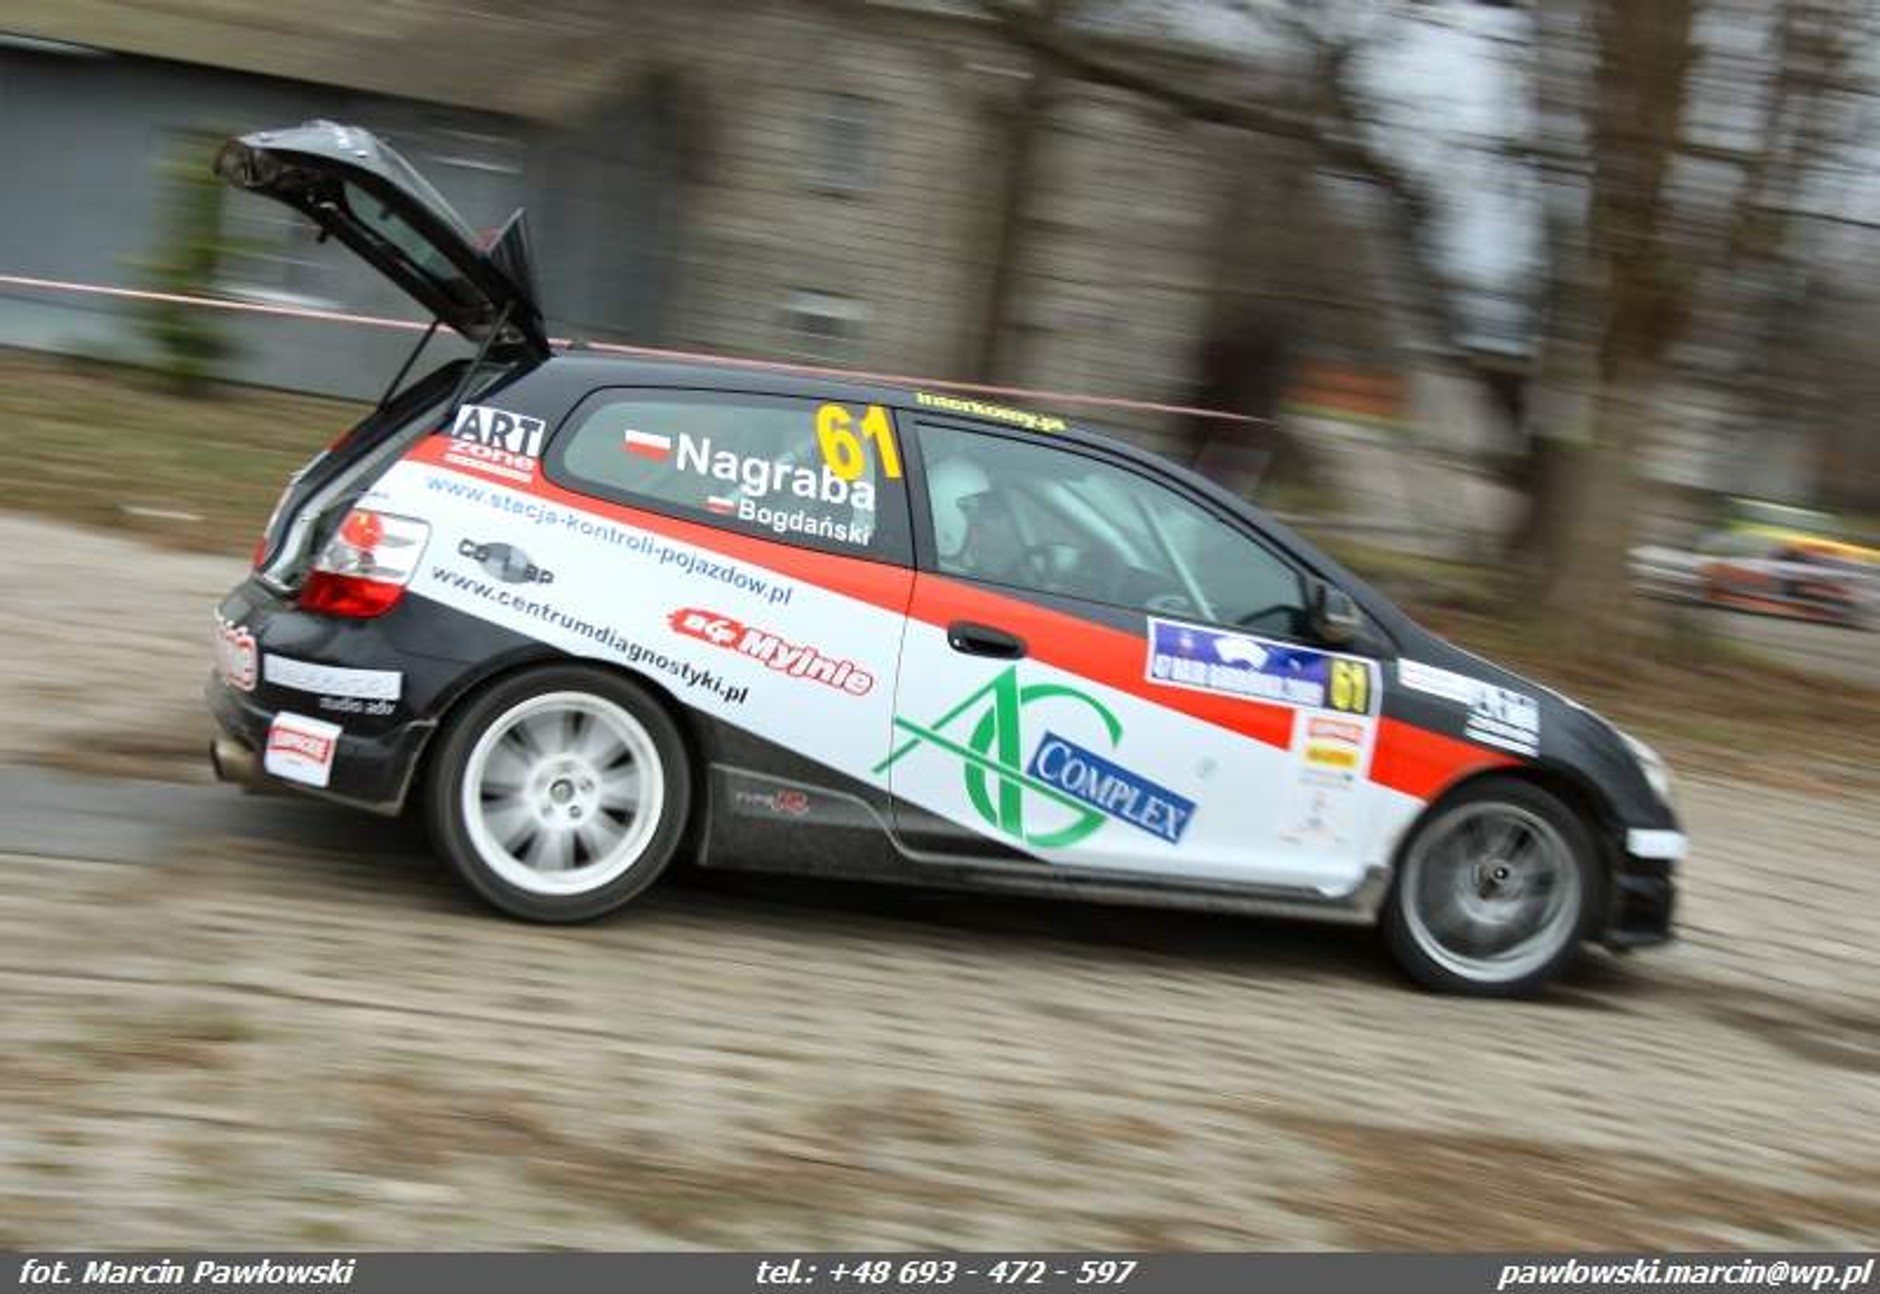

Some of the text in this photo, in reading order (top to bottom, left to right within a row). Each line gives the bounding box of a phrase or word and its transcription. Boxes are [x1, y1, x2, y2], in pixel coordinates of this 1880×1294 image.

[450, 441, 533, 473] zone
[452, 408, 542, 455] ART
[814, 402, 902, 480] 61
[676, 432, 876, 512] Nagraba
[737, 499, 873, 547] Bogdański
[432, 565, 750, 705] www.centrumdiagnostyki.pl
[738, 627, 874, 697] Myjnie
[1035, 740, 1188, 840] COMPLEX
